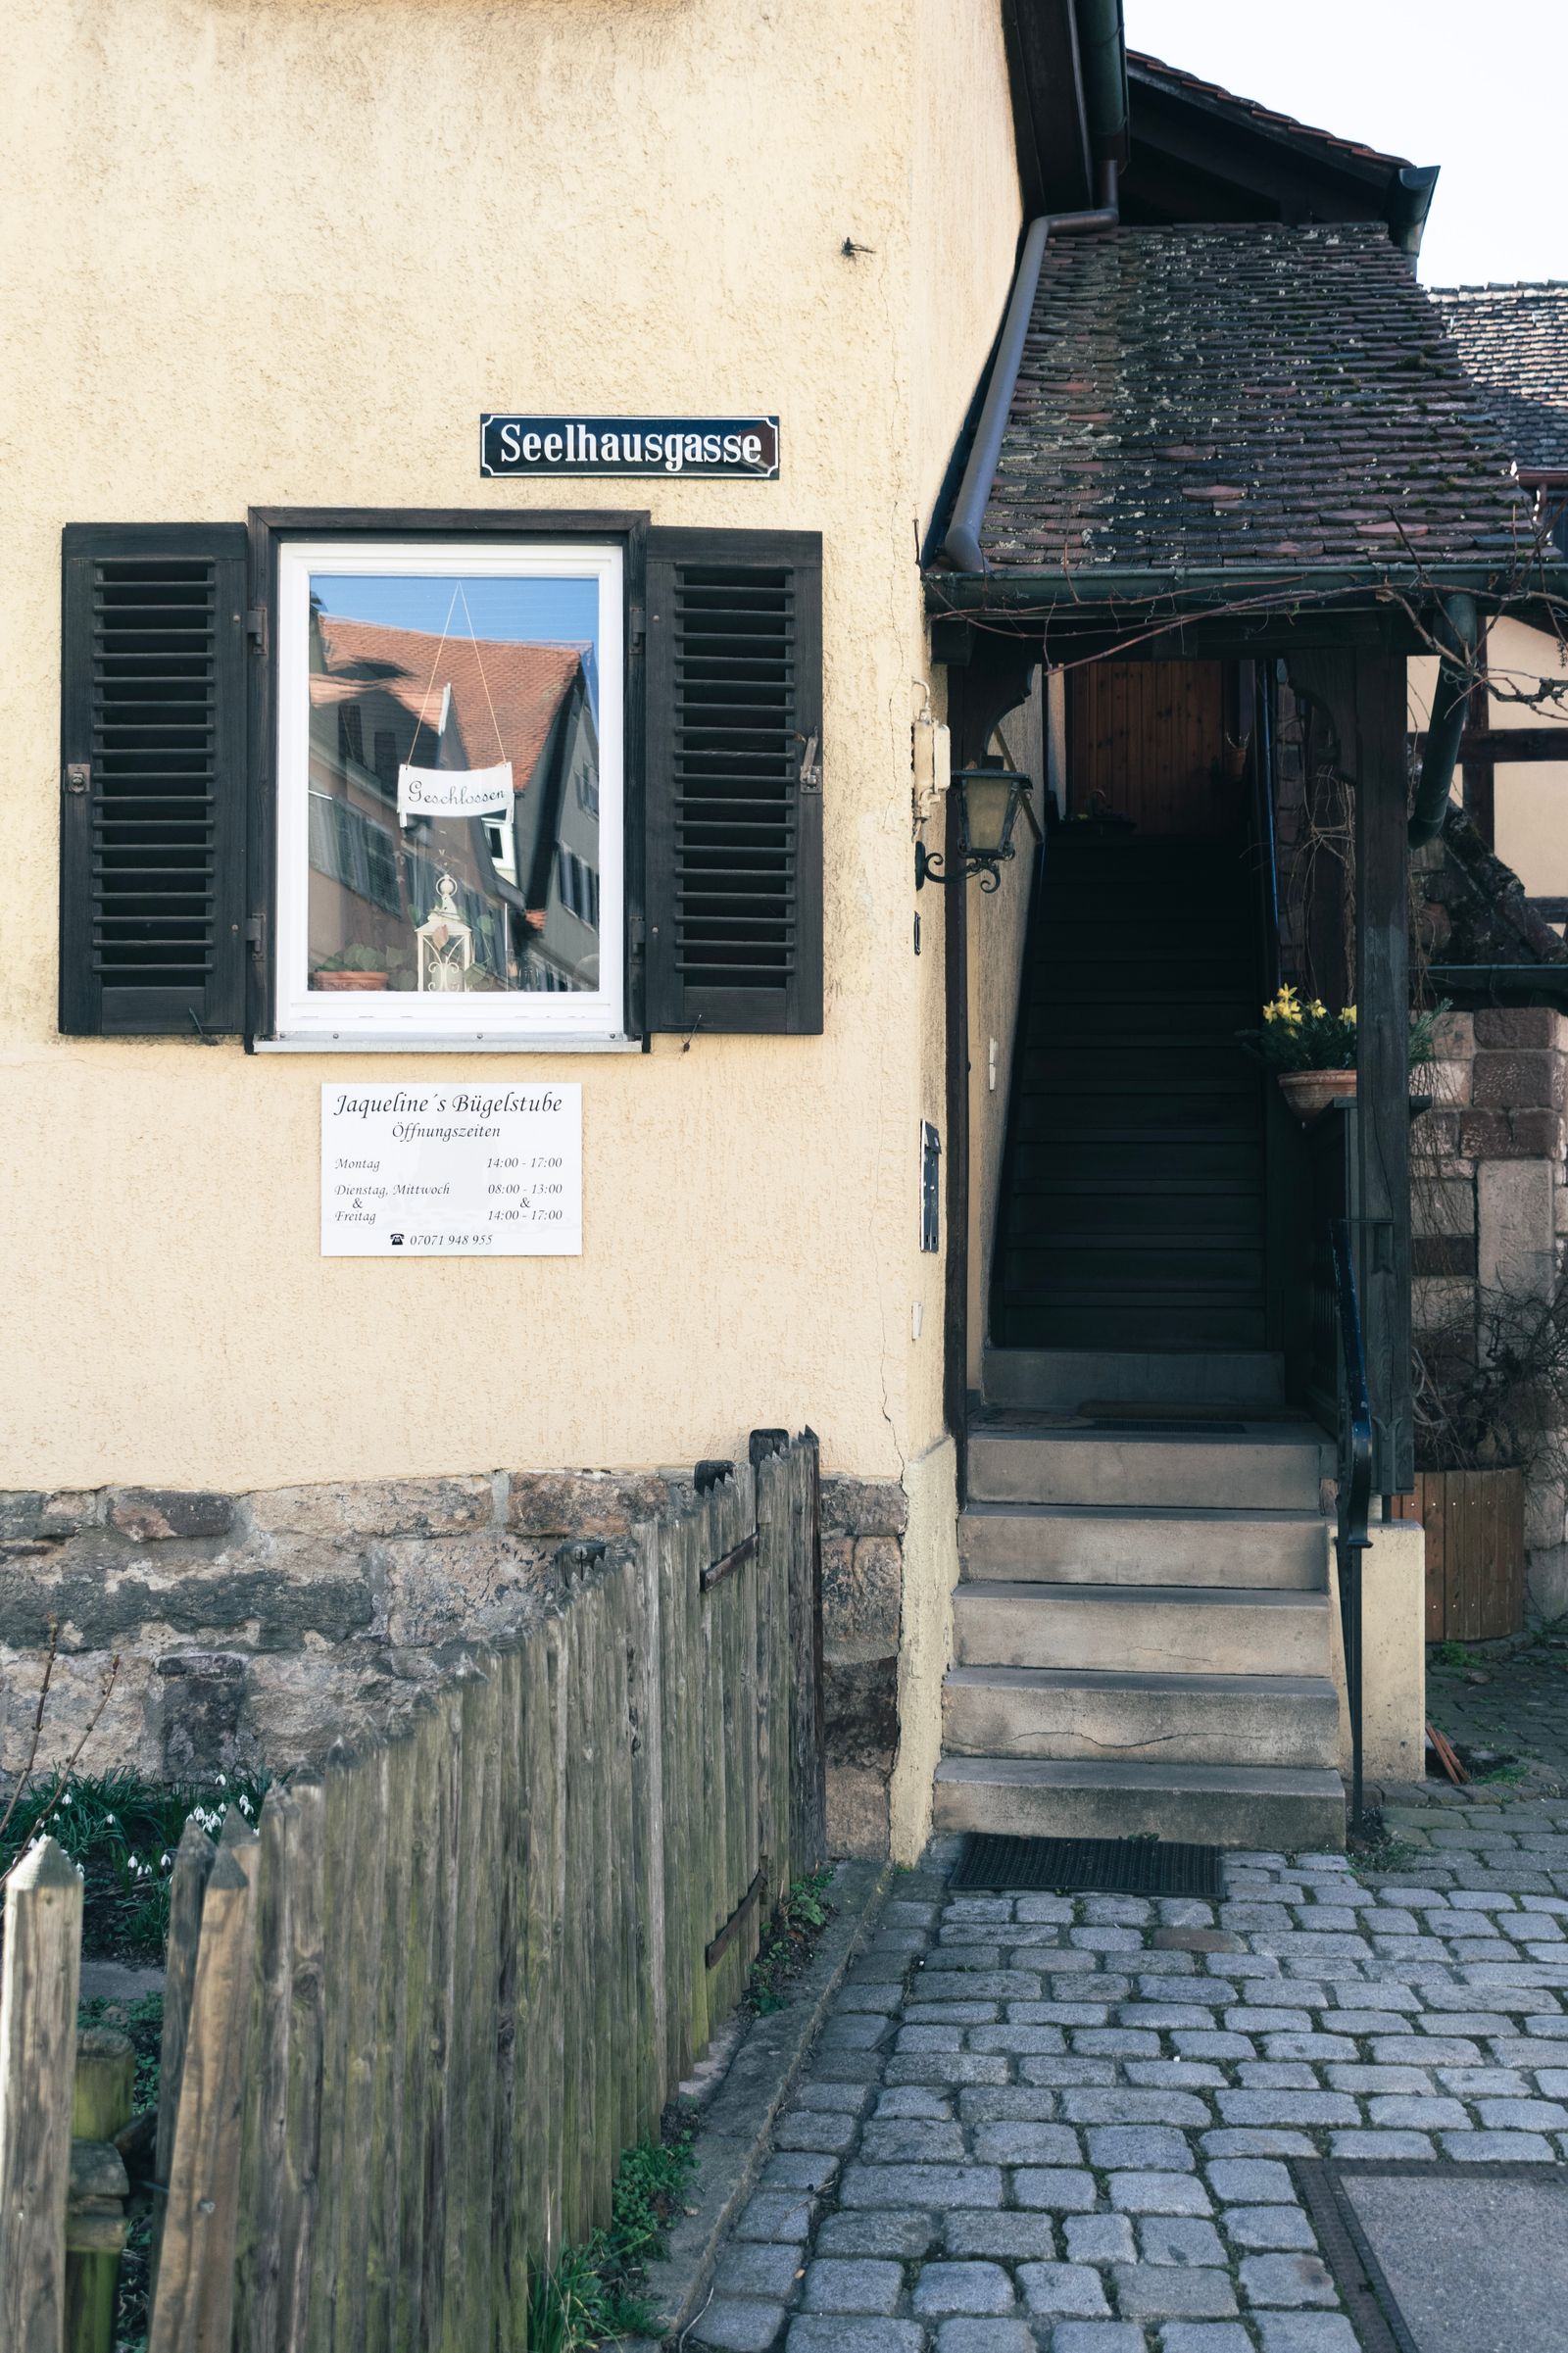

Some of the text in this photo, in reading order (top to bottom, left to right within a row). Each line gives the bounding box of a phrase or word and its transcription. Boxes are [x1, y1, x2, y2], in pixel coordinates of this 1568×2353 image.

[500, 422, 762, 472] Seelhausgasse
[408, 780, 505, 805] Geschlossen
[452, 1091, 563, 1119] Bügelstube
[392, 1121, 501, 1143] Öffnungszeiten
[334, 1157, 381, 1173] Montag
[487, 1156, 519, 1168] 14:00
[530, 1156, 563, 1168] 17:00
[334, 1184, 389, 1199] Dienstag,
[392, 1182, 450, 1195] Mittwoch
[488, 1183, 520, 1195] 08:00
[531, 1183, 563, 1195] 13:00
[352, 1196, 531, 1209] & &
[334, 1210, 377, 1225] Freitag
[488, 1209, 519, 1221] 14:00
[531, 1209, 563, 1221] 17:00
[410, 1234, 493, 1246] 07071 948 955
